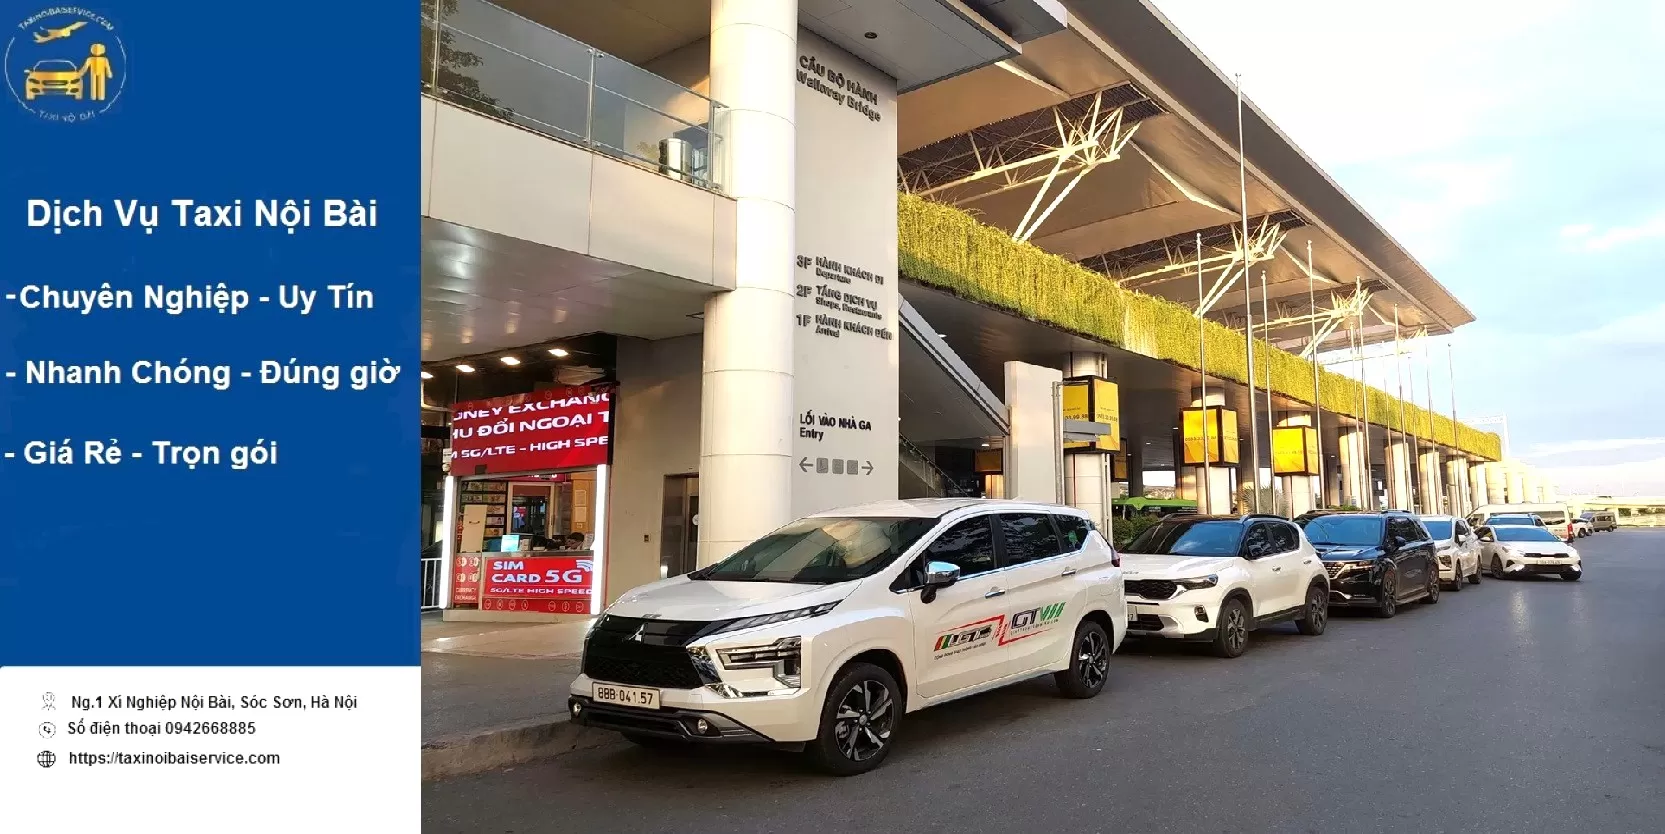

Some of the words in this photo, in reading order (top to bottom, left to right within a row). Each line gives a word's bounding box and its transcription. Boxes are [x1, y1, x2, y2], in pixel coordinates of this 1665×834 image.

[846, 80, 878, 105] HÀNH
[847, 95, 881, 122] Bridge
[796, 254, 812, 269] 3F
[815, 256, 841, 272] HÀNH
[843, 264, 873, 282] KHÁCH
[796, 284, 812, 298] 2F
[796, 314, 811, 327] 1F
[815, 314, 841, 329] HÀNH
[843, 321, 873, 336] KHÁCH
[476, 417, 515, 438] ĐỔI
[519, 412, 592, 433] NGOẠI
[800, 409, 815, 426] LỐI
[818, 412, 837, 427] VÀO
[838, 415, 858, 430] NHÀ
[858, 420, 872, 431] GA
[530, 439, 571, 452] HIGH
[574, 435, 609, 448] SPE
[799, 427, 824, 442] Entry
[491, 573, 542, 583] CARD
[545, 569, 583, 583] 5G
[492, 560, 525, 571] SIM
